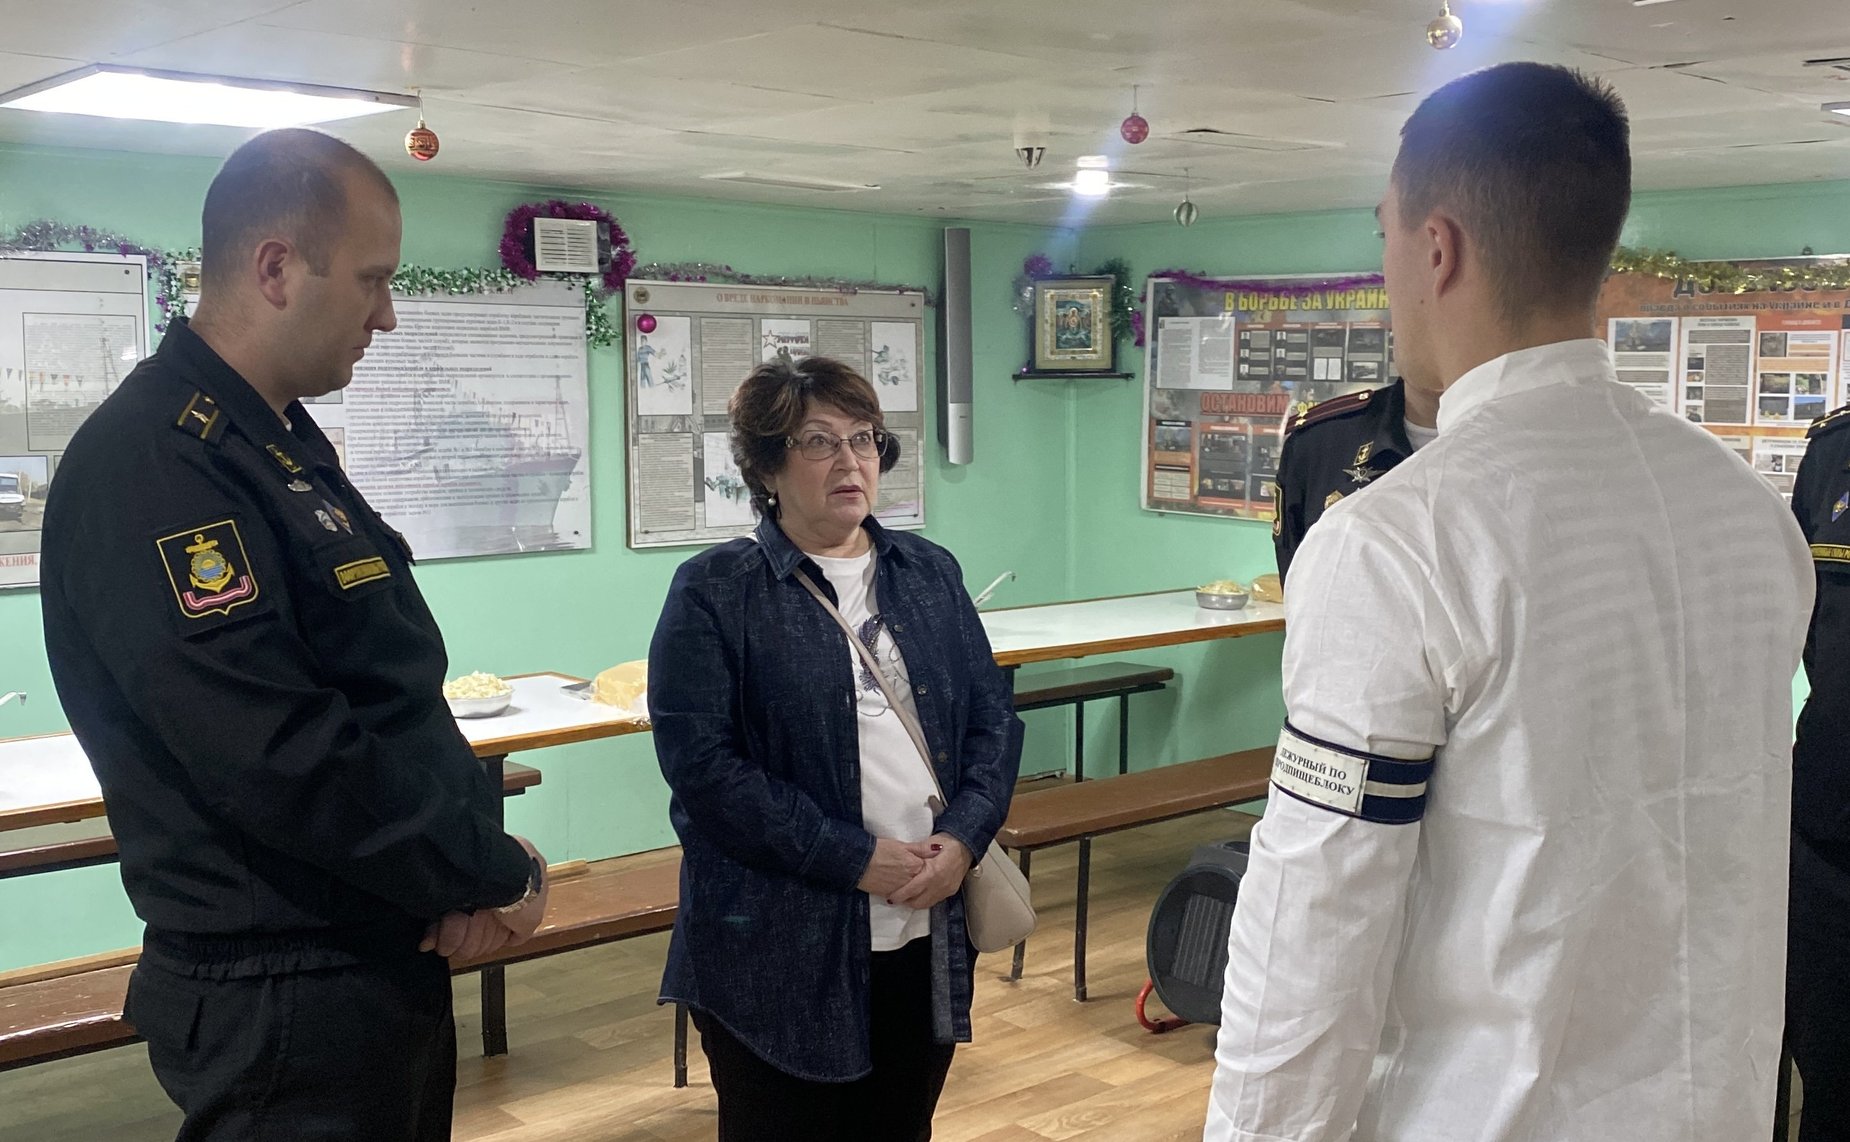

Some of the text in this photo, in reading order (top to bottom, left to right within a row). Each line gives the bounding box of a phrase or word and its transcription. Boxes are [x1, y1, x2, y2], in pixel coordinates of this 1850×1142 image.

[1225, 292, 1234, 311] В
[1302, 292, 1322, 310] ЗА
[1325, 288, 1390, 310] УКРАИН
[1201, 392, 1289, 413] ОСТАНОВИМ
[1329, 765, 1347, 780] ПО
